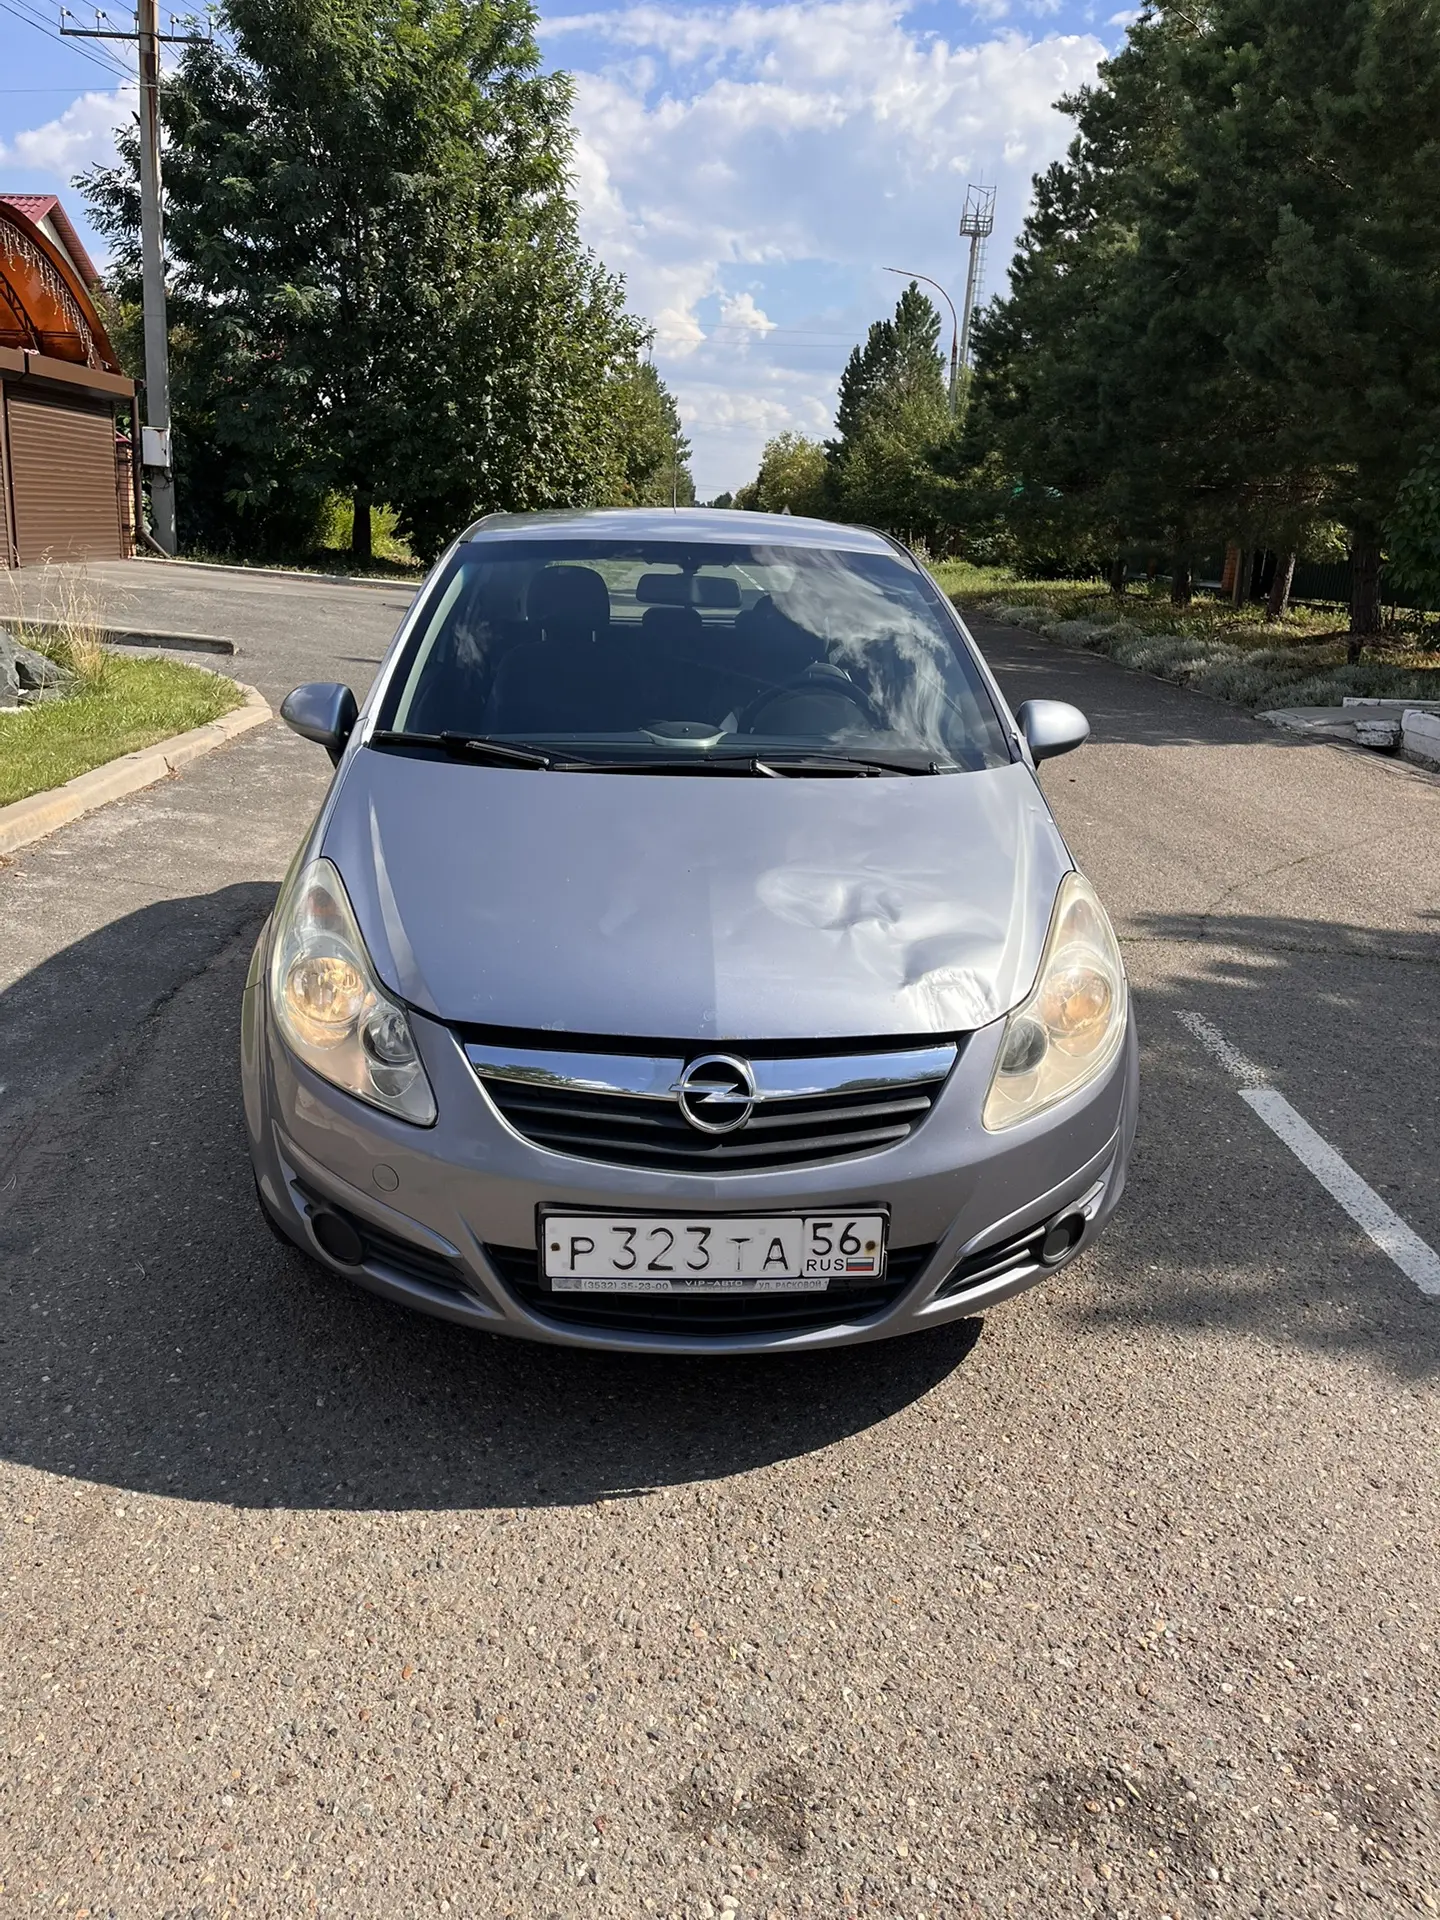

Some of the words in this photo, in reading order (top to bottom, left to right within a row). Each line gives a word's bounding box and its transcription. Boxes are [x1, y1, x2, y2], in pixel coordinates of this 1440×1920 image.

[811, 1221, 861, 1256] 56
[806, 1258, 844, 1272] RUS
[583, 1281, 617, 1291] (3532)
